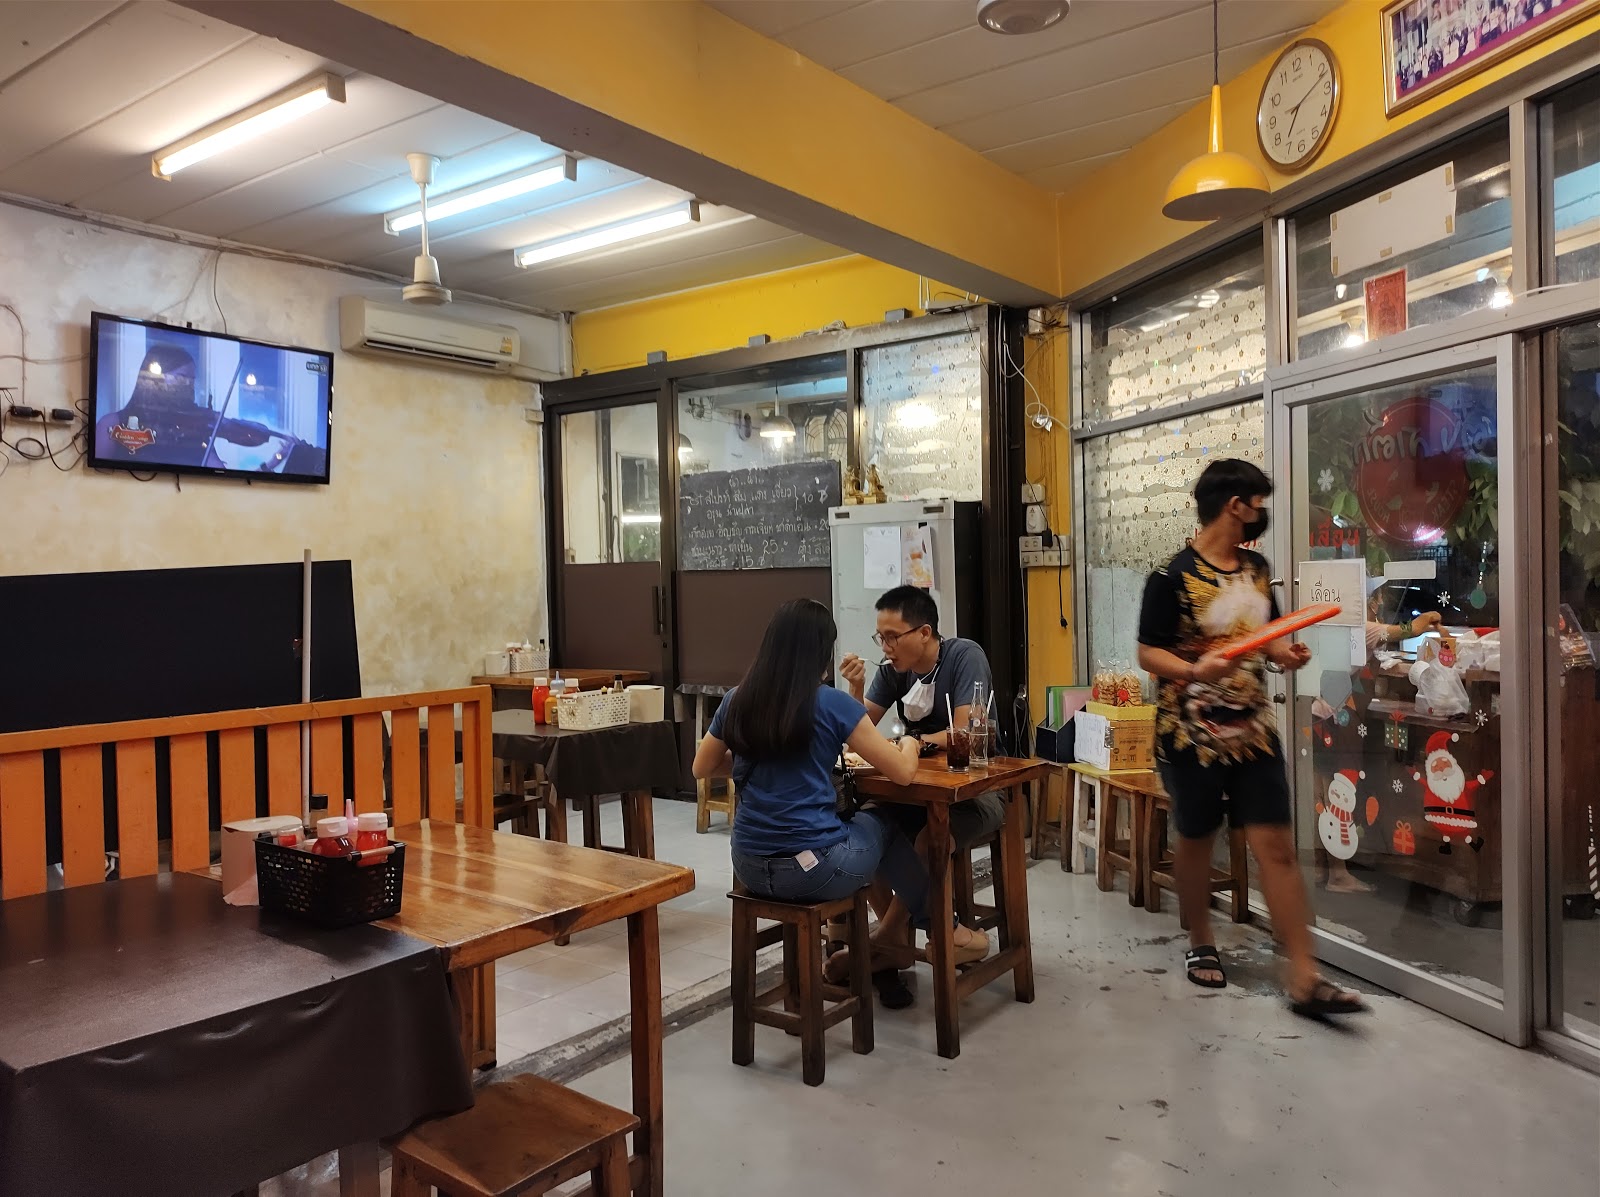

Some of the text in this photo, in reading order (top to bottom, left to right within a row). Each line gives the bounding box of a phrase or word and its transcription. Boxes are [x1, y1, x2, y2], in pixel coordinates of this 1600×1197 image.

[1292, 57, 1302, 72] 12
[1317, 62, 1326, 78] 2
[1279, 71, 1288, 86] 11
[1323, 81, 1332, 95] 3
[1269, 93, 1281, 109] 10
[1320, 104, 1328, 118] 4
[1269, 115, 1277, 129] 9
[1274, 132, 1282, 146] 8
[1311, 126, 1320, 140] 5
[1285, 141, 1293, 155] 7
[1297, 139, 1306, 153] 6
